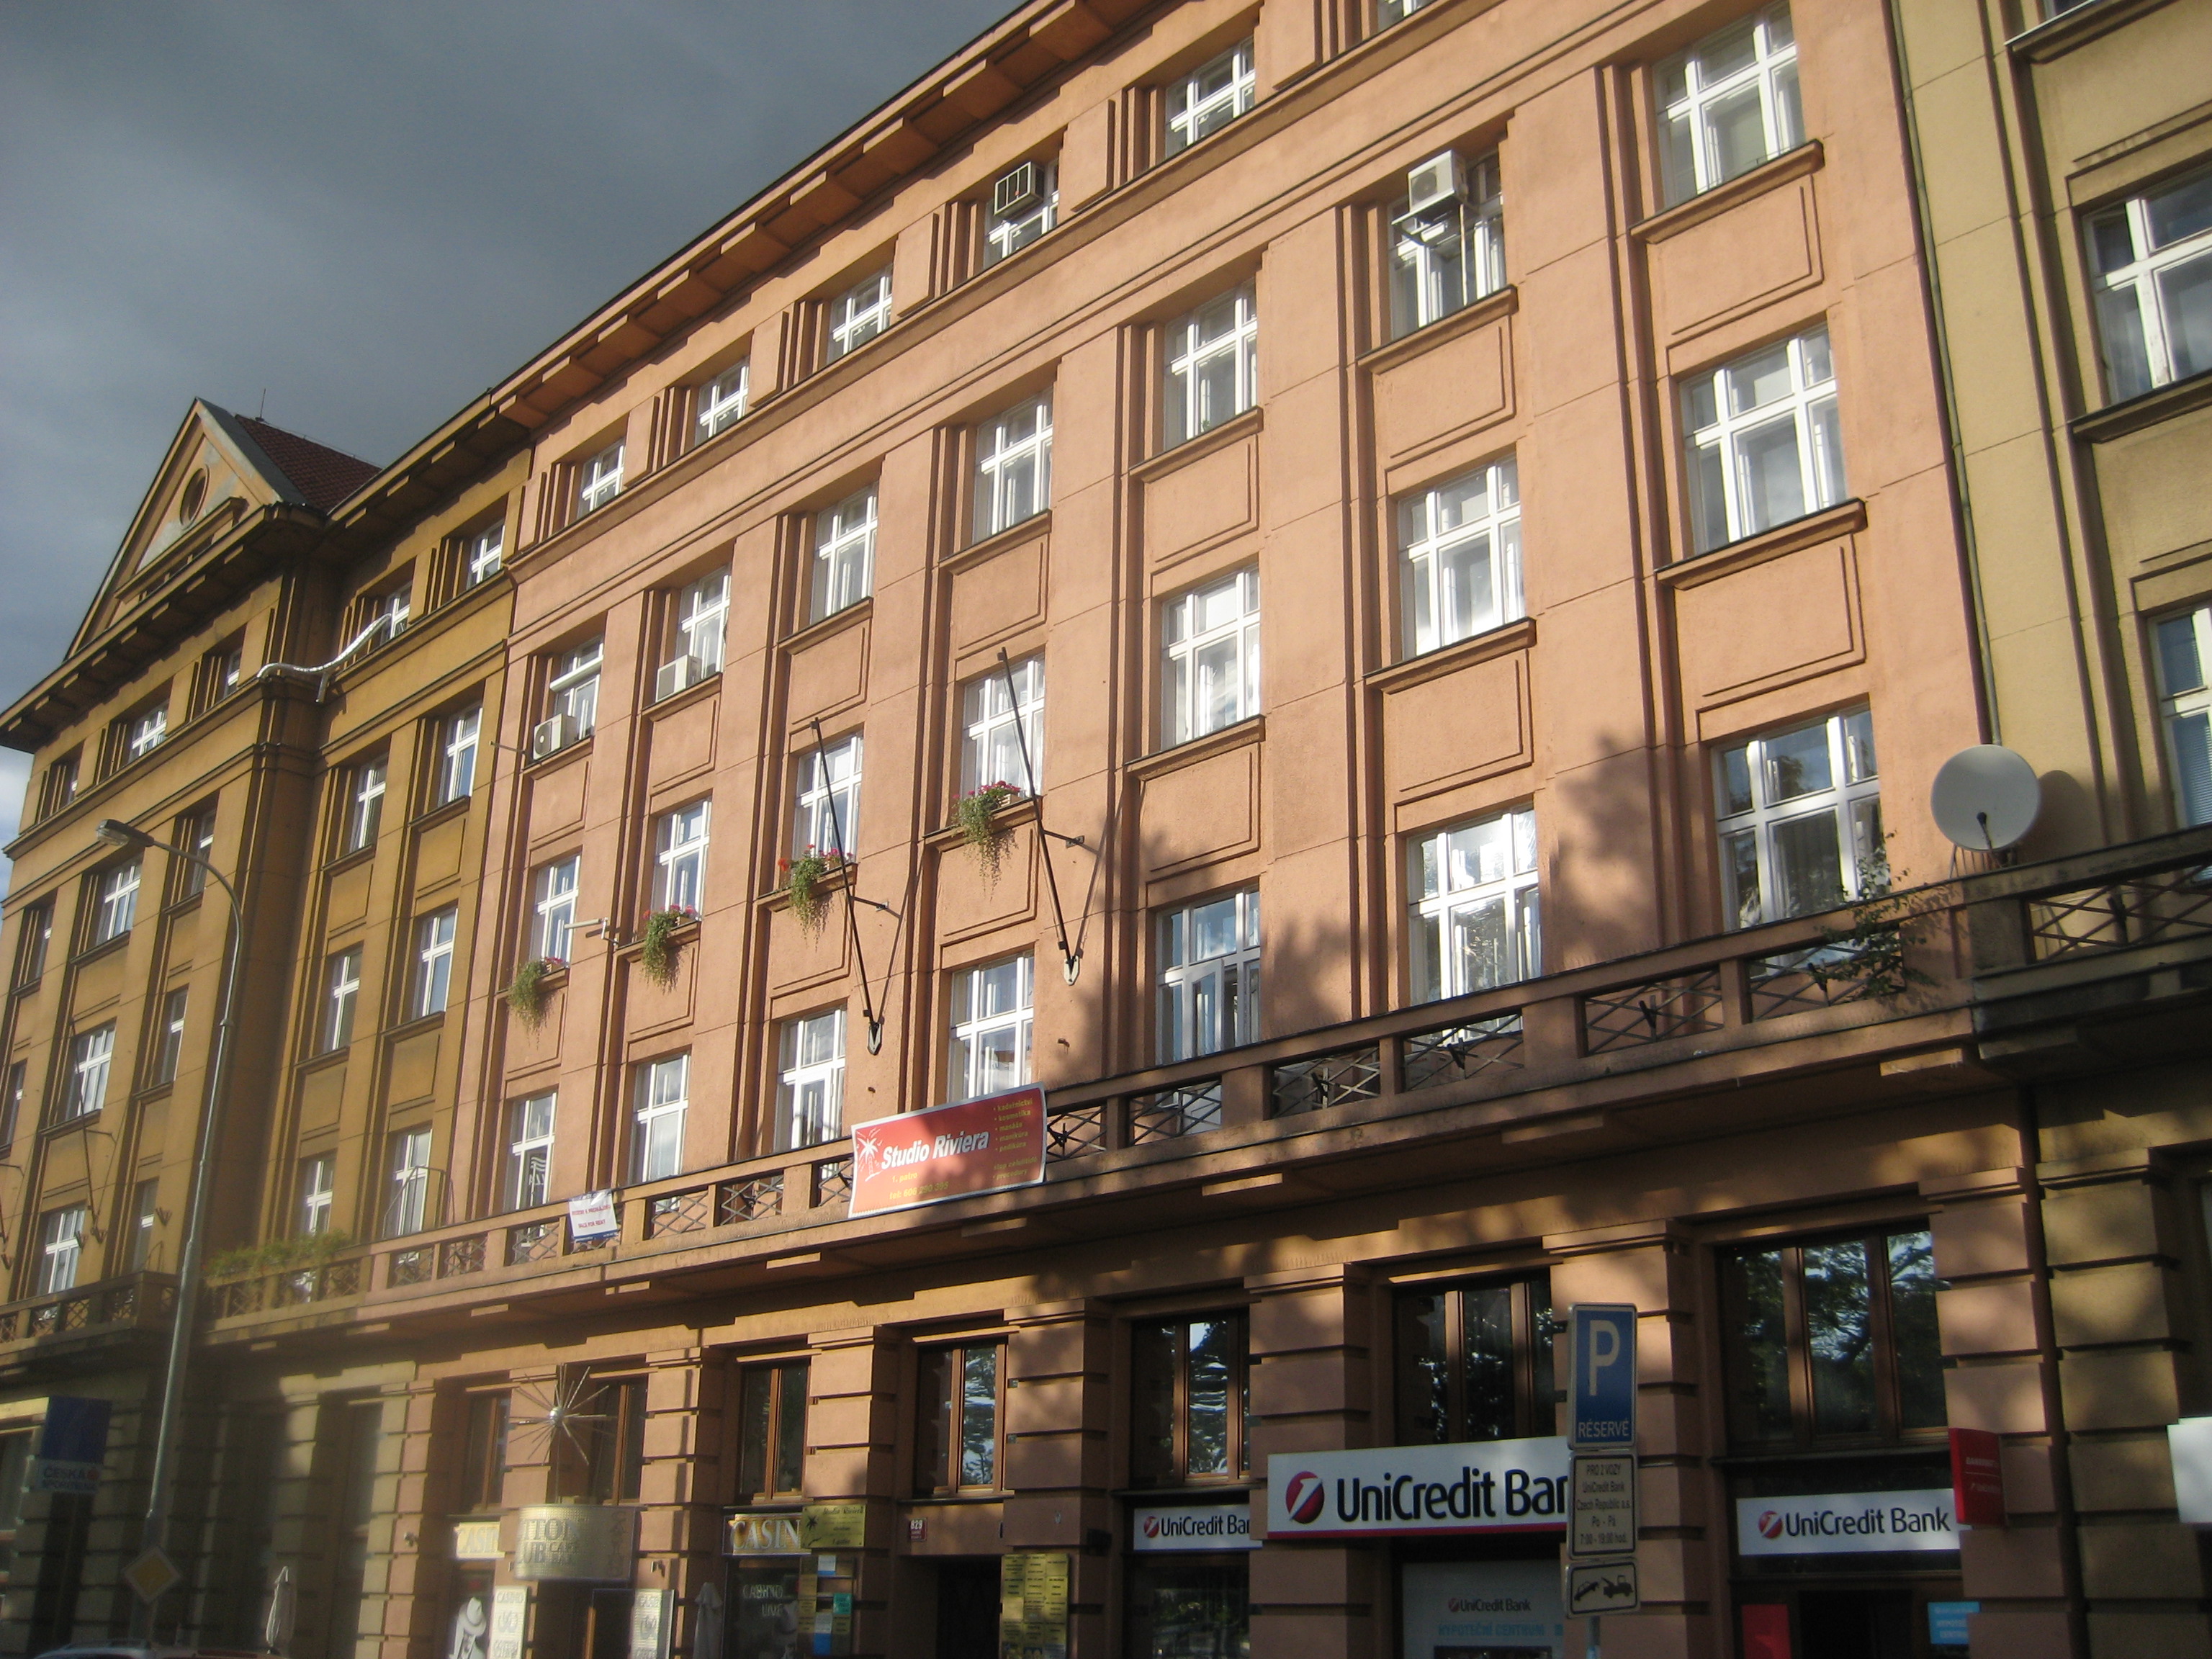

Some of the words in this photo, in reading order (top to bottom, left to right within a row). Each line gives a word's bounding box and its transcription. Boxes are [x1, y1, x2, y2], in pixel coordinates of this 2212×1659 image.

[998, 1110, 1031, 1121] kosmetika
[881, 1141, 930, 1170] Studio
[932, 1130, 990, 1159] Riviera
[899, 1172, 918, 1183] patro
[889, 1190, 902, 1200] tel:
[1588, 1319, 1621, 1396] P
[1578, 1418, 1629, 1438] RÉSERVÉ
[1586, 1465, 1599, 1475] PRO
[1605, 1463, 1621, 1475] VOZY
[1337, 1466, 1496, 1522] UniCredit
[1582, 1481, 1609, 1493] UniCredit
[1610, 1480, 1625, 1492] Bank
[1595, 1498, 1619, 1511] Republic
[1161, 1515, 1224, 1537] UniCredit
[1786, 1509, 1885, 1537] UniCredit
[1891, 1506, 1951, 1533] Bank
[729, 1519, 801, 1550] CASIN
[1460, 1598, 1505, 1612] UniCredit
[1506, 1598, 1531, 1611] Bank
